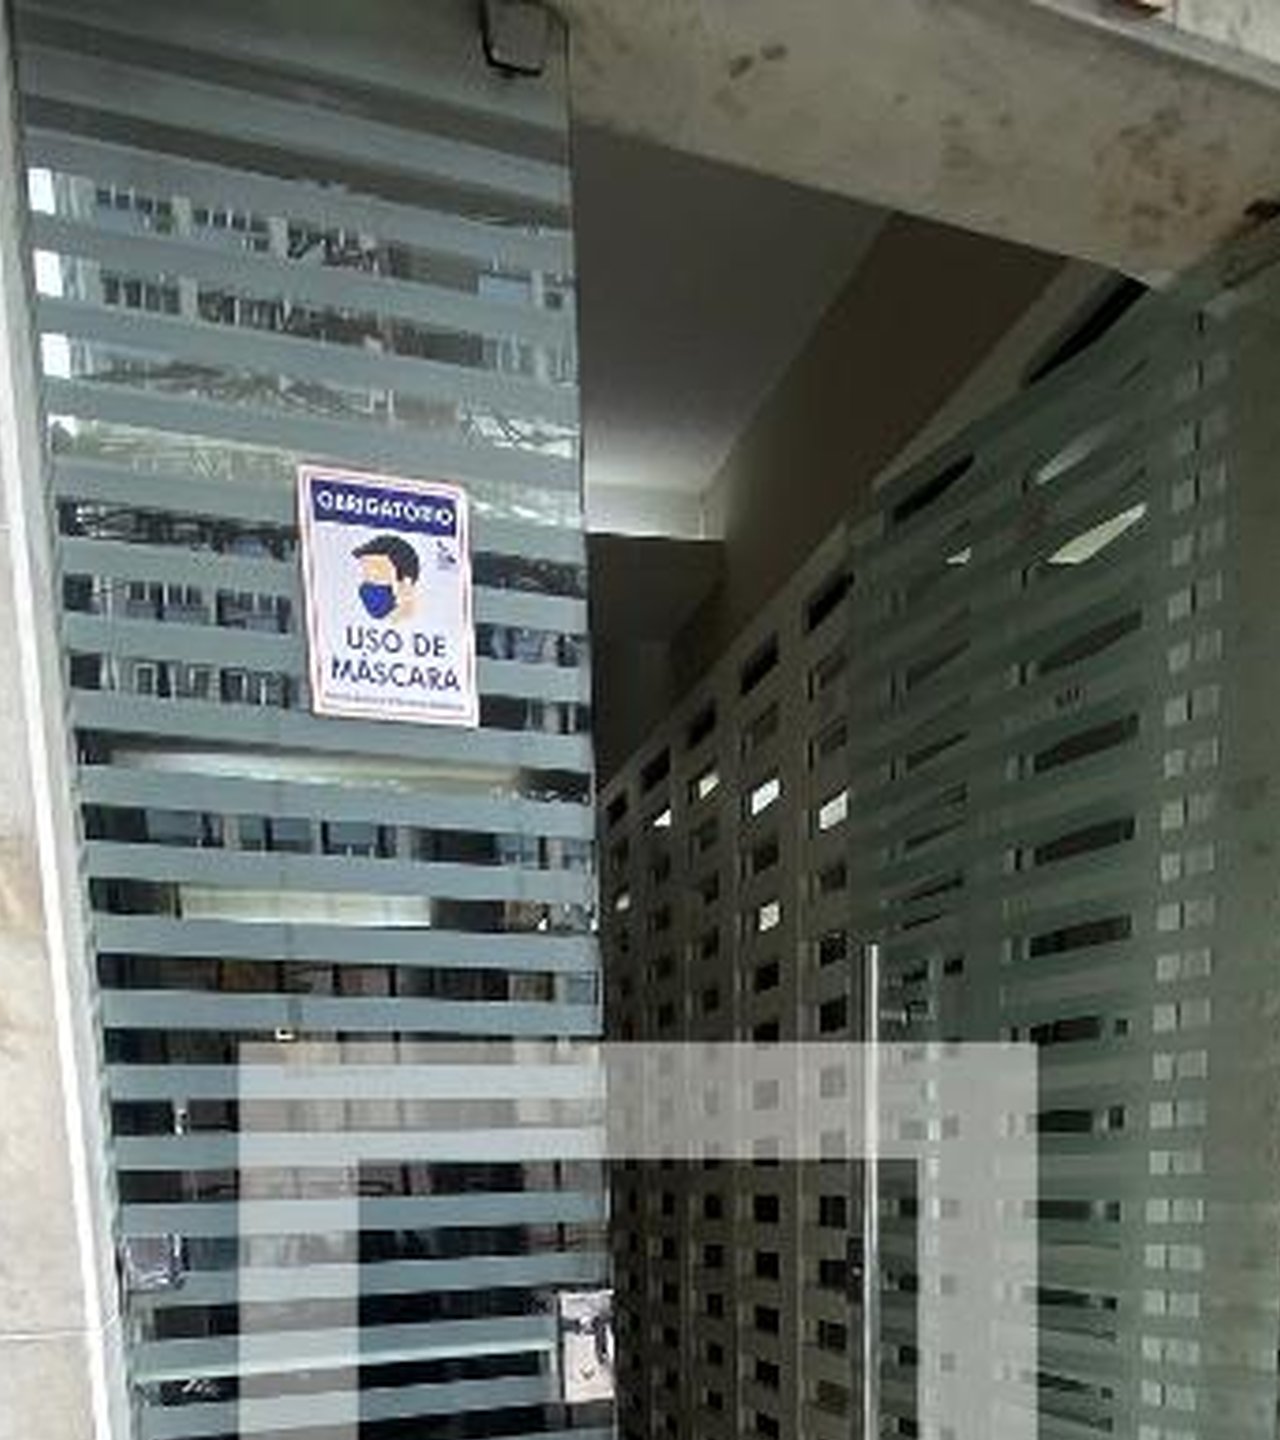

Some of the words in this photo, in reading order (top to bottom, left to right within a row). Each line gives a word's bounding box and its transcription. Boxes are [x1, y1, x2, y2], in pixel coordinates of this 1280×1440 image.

[345, 626, 404, 652] USO
[413, 631, 447, 658] DE
[330, 651, 462, 692] MÁSCARA
